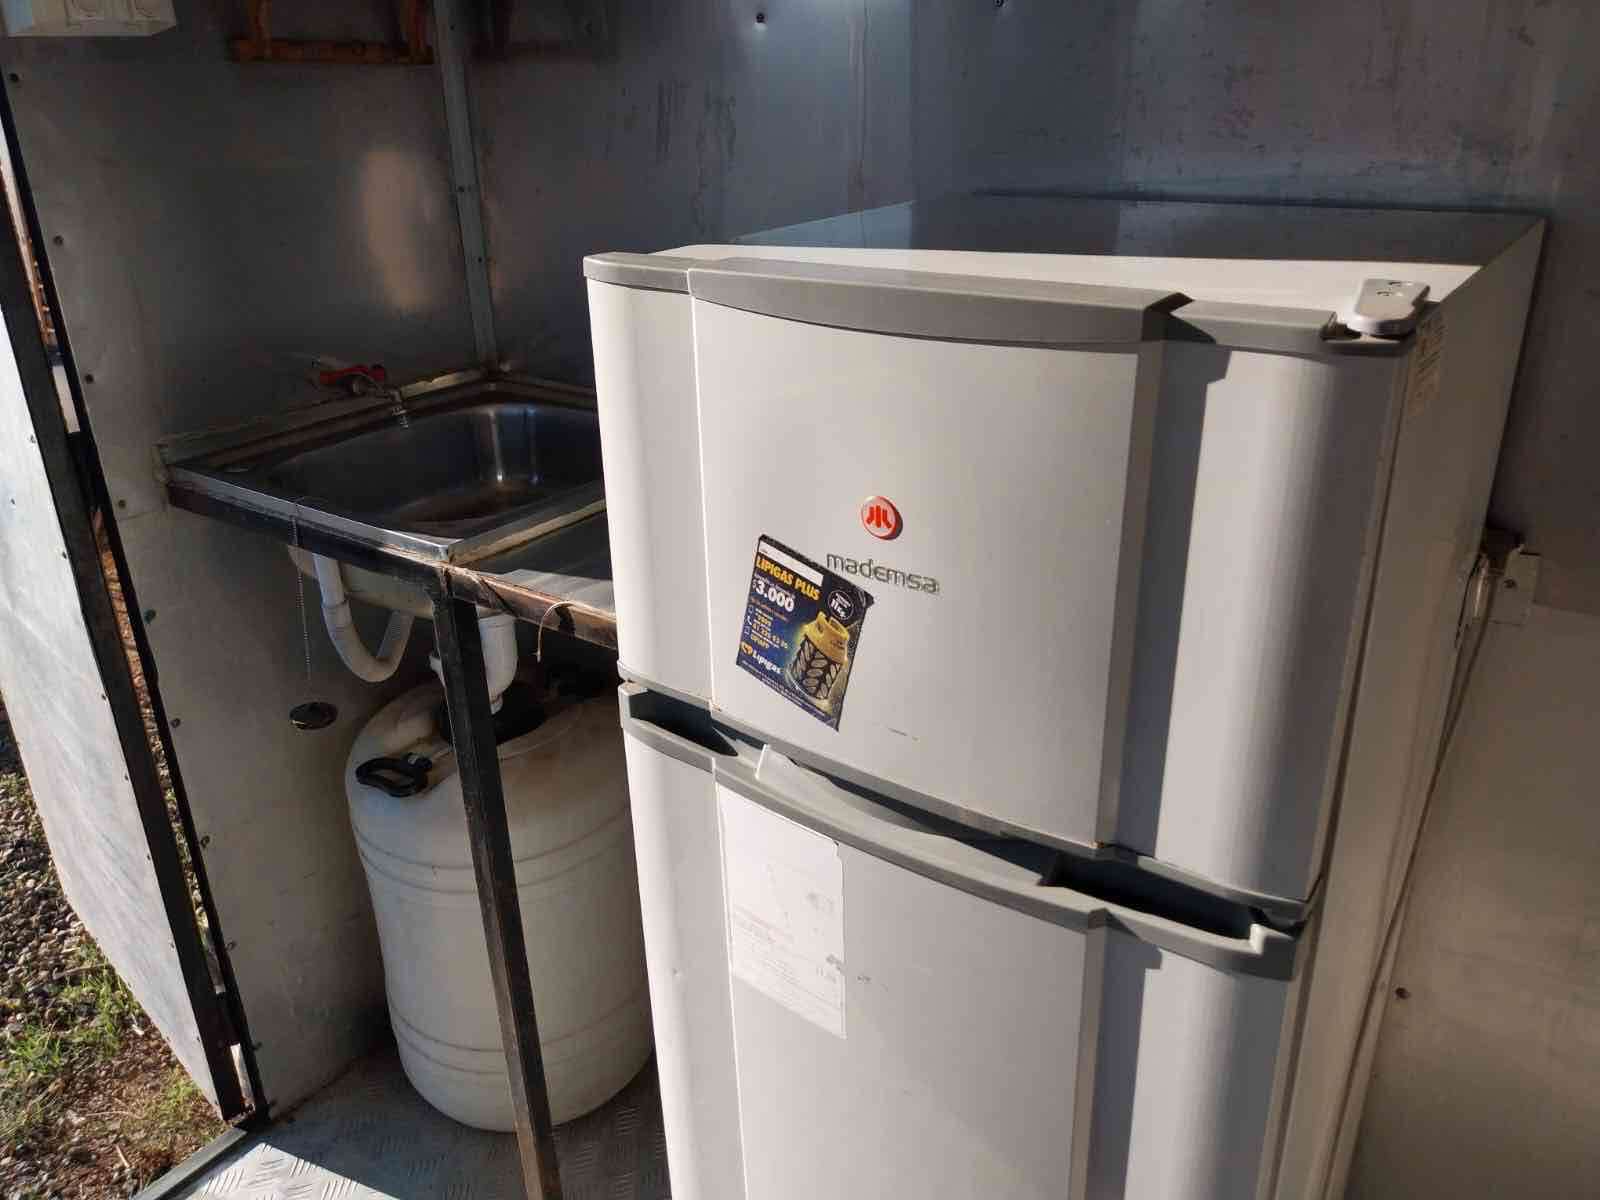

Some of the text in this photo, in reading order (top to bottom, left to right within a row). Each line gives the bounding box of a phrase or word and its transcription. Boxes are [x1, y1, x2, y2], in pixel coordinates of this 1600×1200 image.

[755, 555, 794, 586] LIPIGAS
[794, 578, 820, 601] PLUS
[826, 553, 940, 594] mademsa
